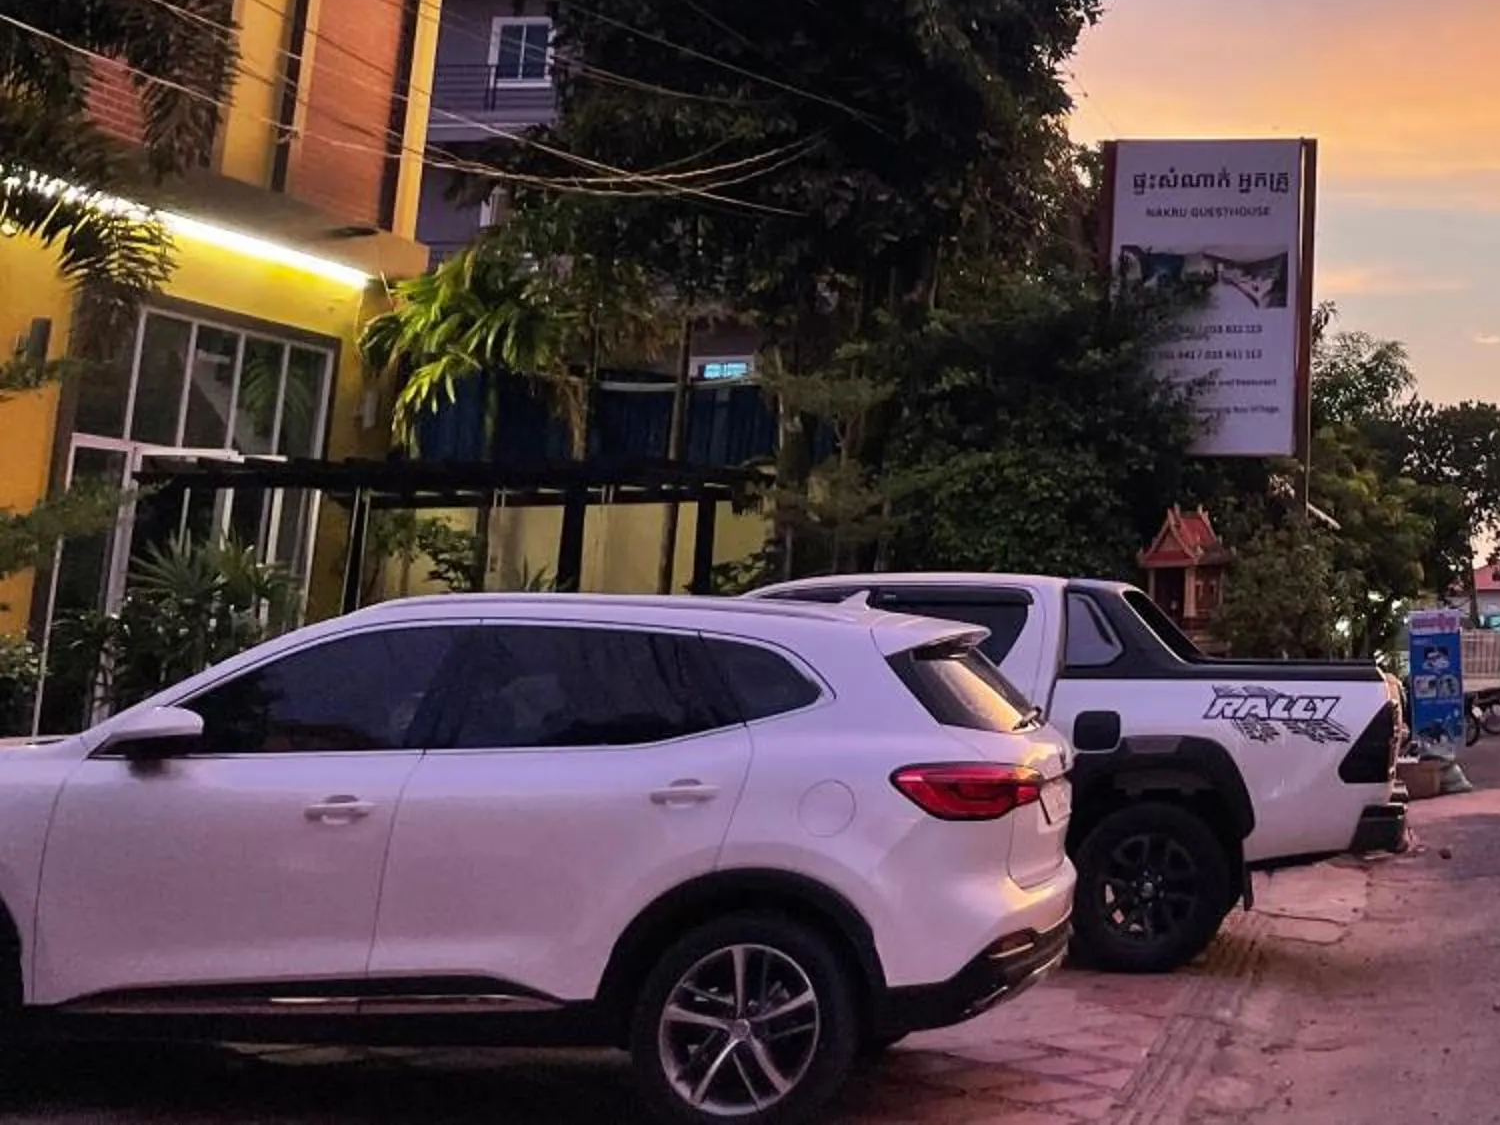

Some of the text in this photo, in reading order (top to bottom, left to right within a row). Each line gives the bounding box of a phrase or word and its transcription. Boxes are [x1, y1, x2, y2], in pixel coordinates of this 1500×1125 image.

[1146, 206, 1271, 218] NAKRU GUESTHOUSE
[1203, 693, 1341, 722] RALLY
